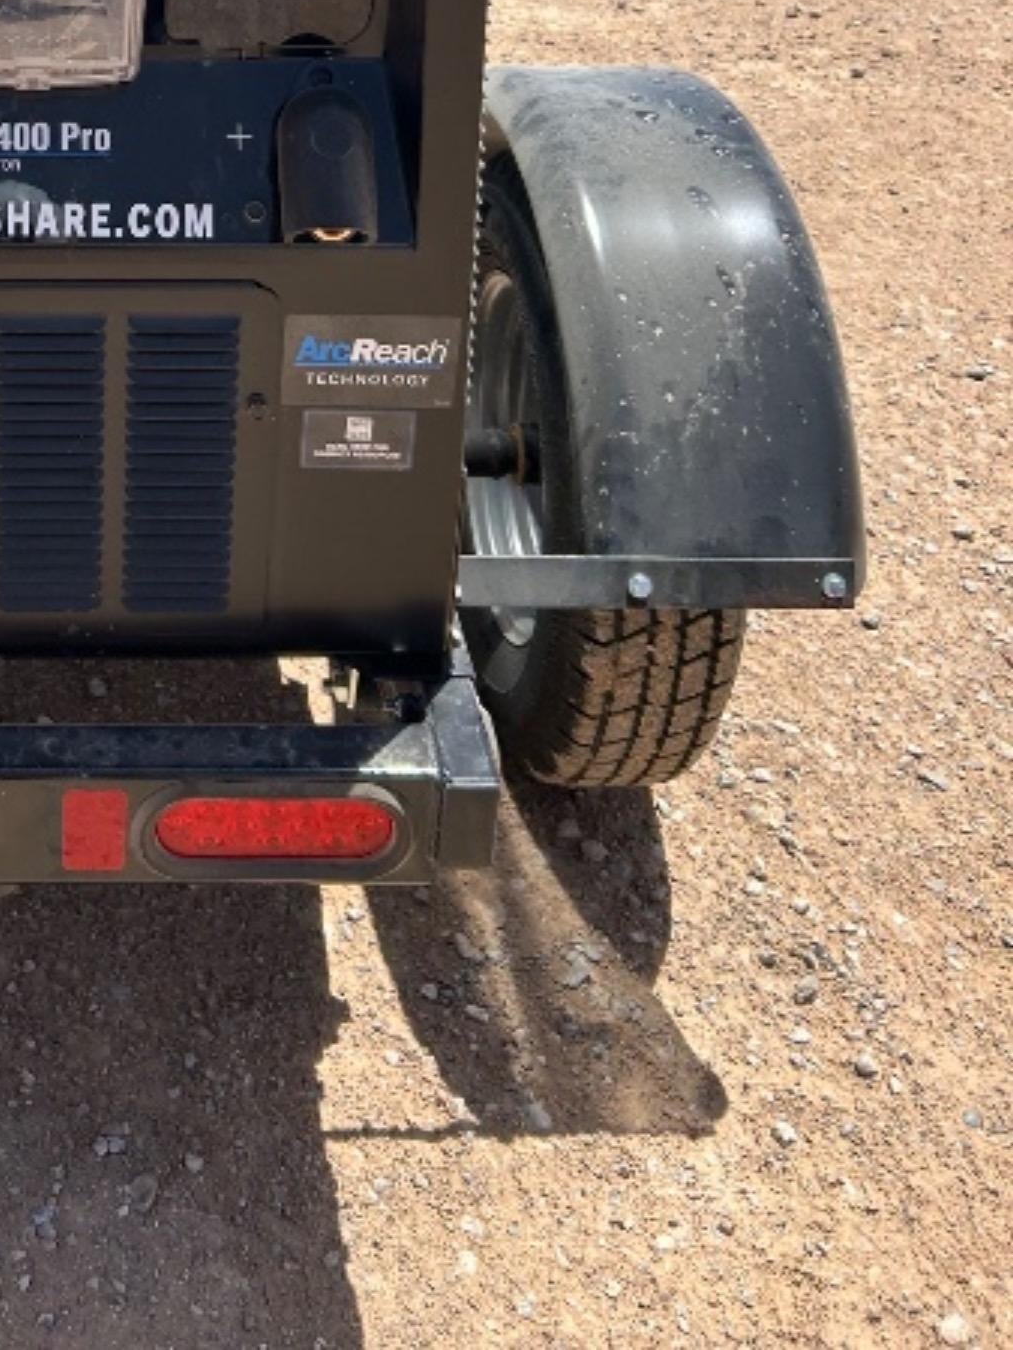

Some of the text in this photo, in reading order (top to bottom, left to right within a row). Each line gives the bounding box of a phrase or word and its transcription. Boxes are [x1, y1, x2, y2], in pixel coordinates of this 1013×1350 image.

[60, 122, 111, 151] Pro
[294, 334, 449, 365] ArcReach
[305, 371, 430, 387] TECHNOLOGY
